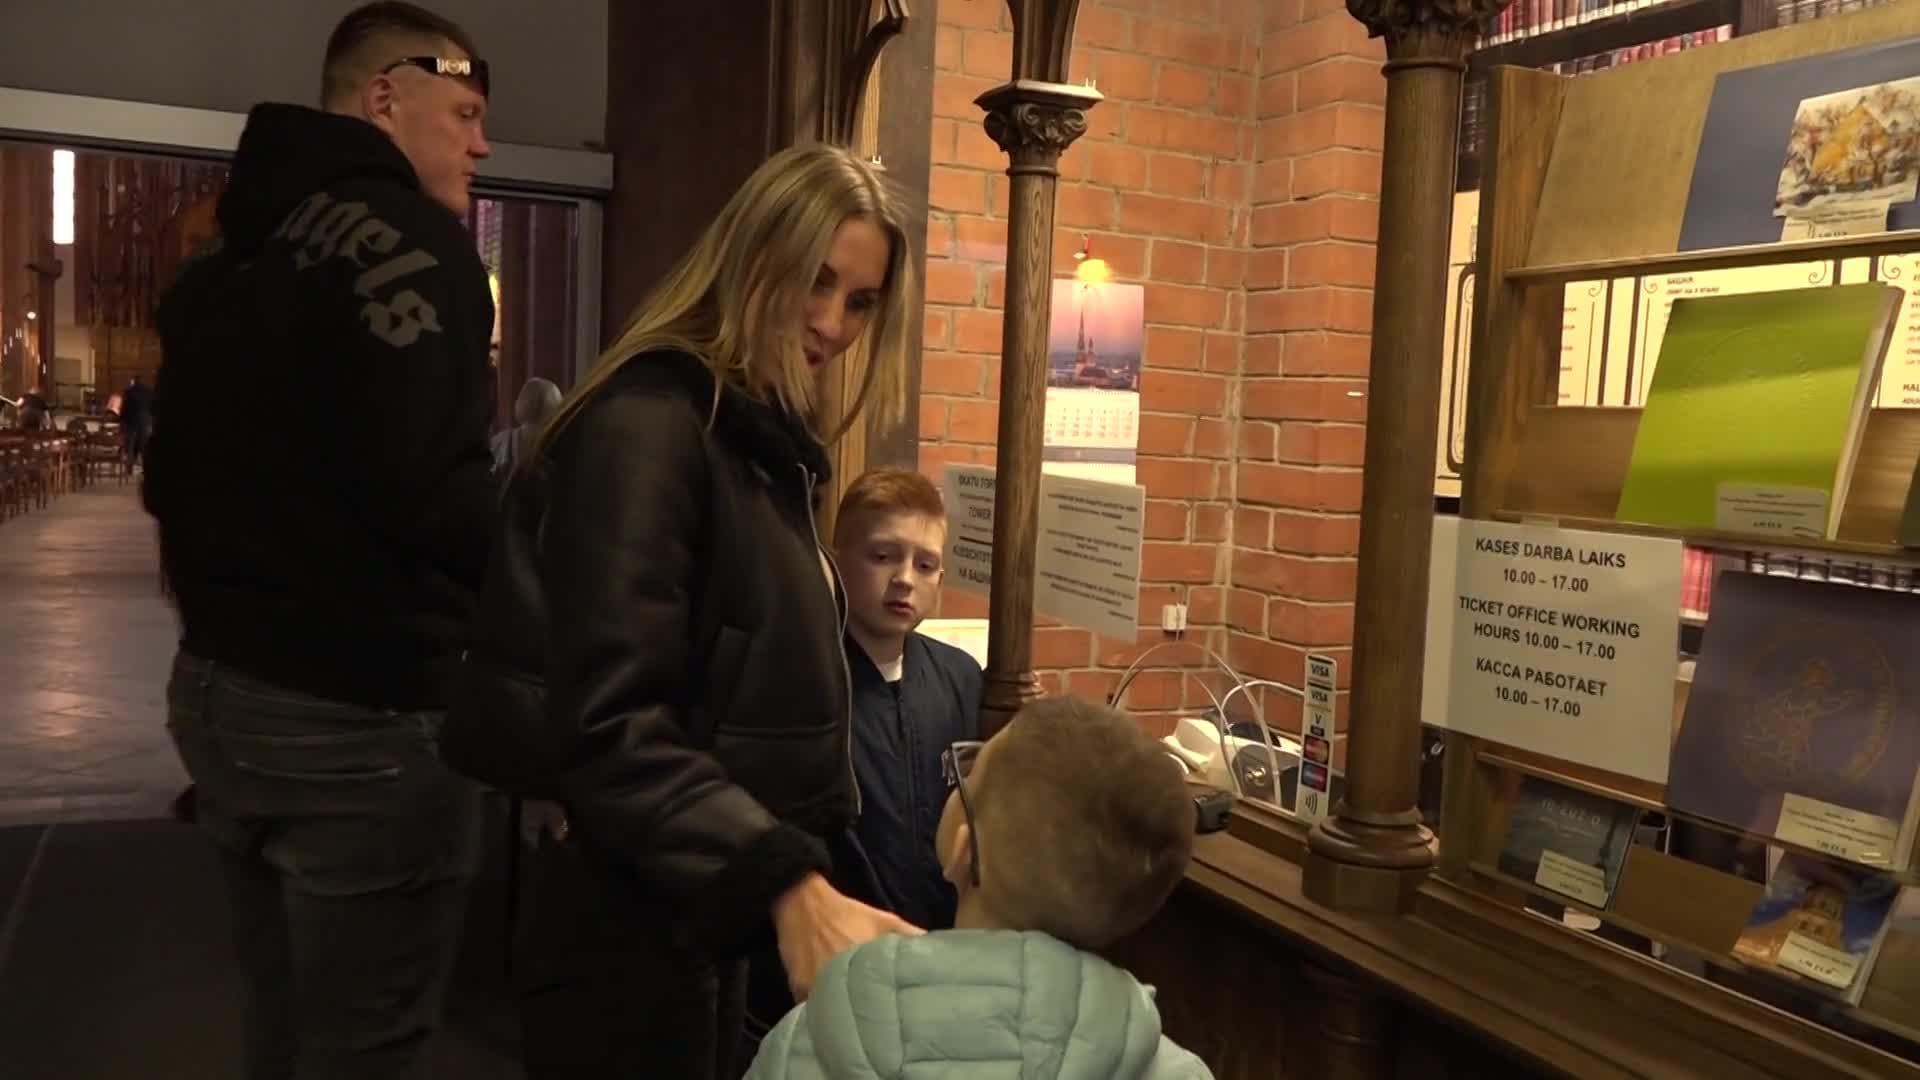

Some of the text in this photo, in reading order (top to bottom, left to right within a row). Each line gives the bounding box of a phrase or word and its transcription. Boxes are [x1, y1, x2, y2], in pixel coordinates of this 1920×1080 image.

[1475, 537, 1627, 569] KASES DARBA LAIKS
[1503, 568, 1536, 586] 10.00
[1552, 575, 1589, 593] 17.00
[1459, 596, 1641, 639] TICKET OFFICE WORKING
[1474, 622, 1521, 643] HOURS
[1525, 630, 1559, 650] 10.00
[1577, 640, 1616, 661] 17.00
[1311, 663, 1330, 678] VISA
[1476, 657, 1608, 697] КАССА РАБОТАЕТ
[1495, 686, 1528, 706] 10.00
[1544, 696, 1581, 717] 17.00
